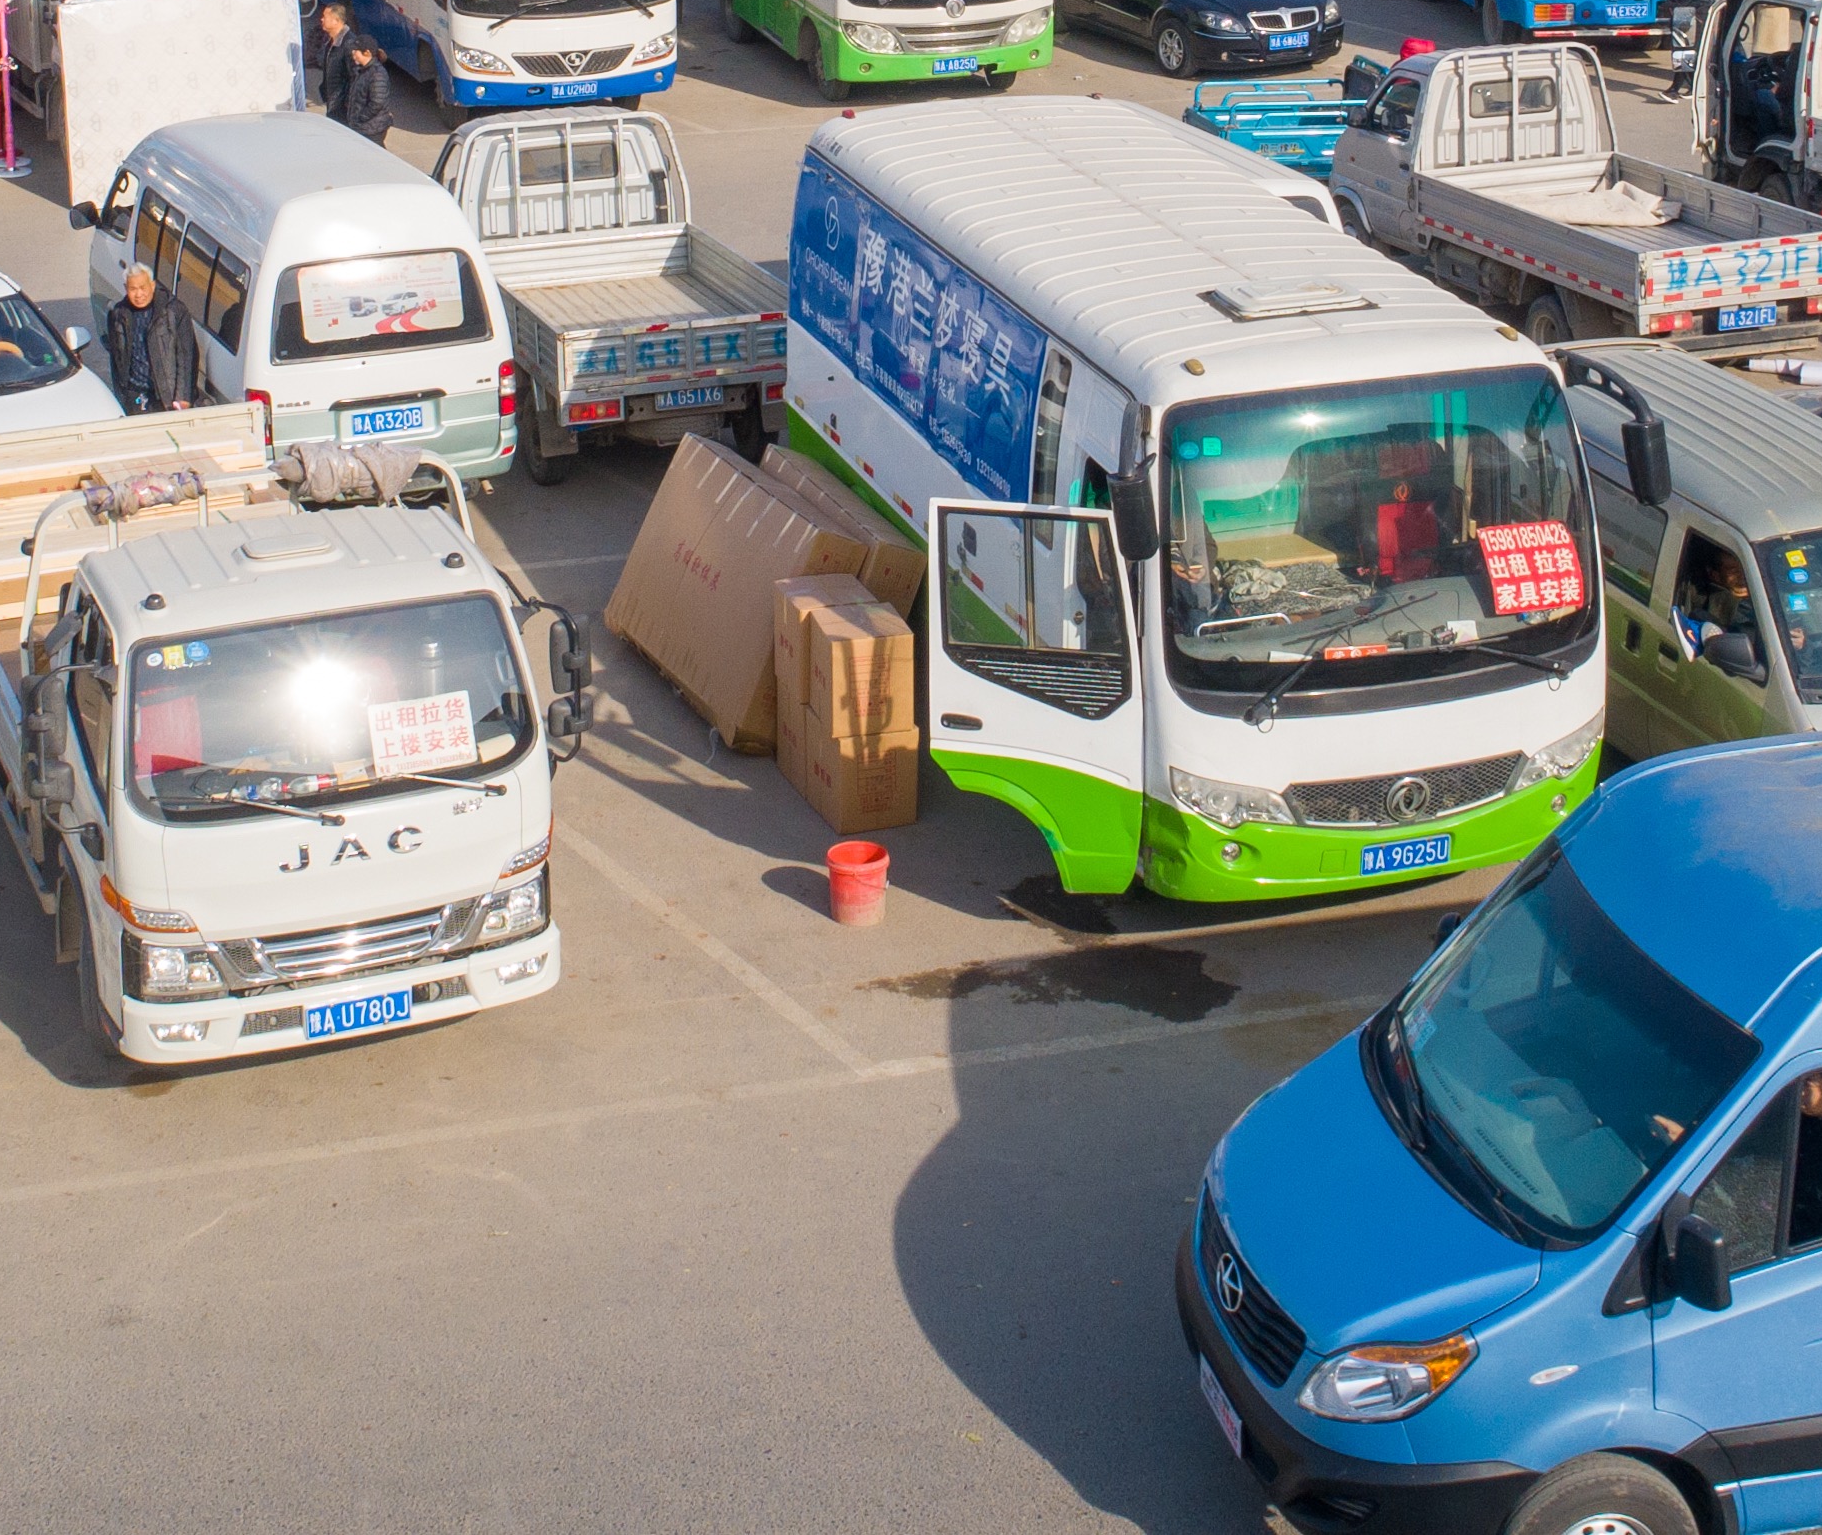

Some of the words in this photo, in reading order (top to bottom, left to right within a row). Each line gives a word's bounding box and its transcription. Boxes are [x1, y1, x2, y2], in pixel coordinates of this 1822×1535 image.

[1480, 522, 1570, 552] 15981850428
[1487, 552, 1521, 579] 出租
[1534, 548, 1575, 574] 拉货
[1496, 576, 1581, 610] 家具安装
[375, 698, 467, 733] 出租拉货
[378, 725, 471, 761] 上楼安装
[278, 825, 424, 873] JAC
